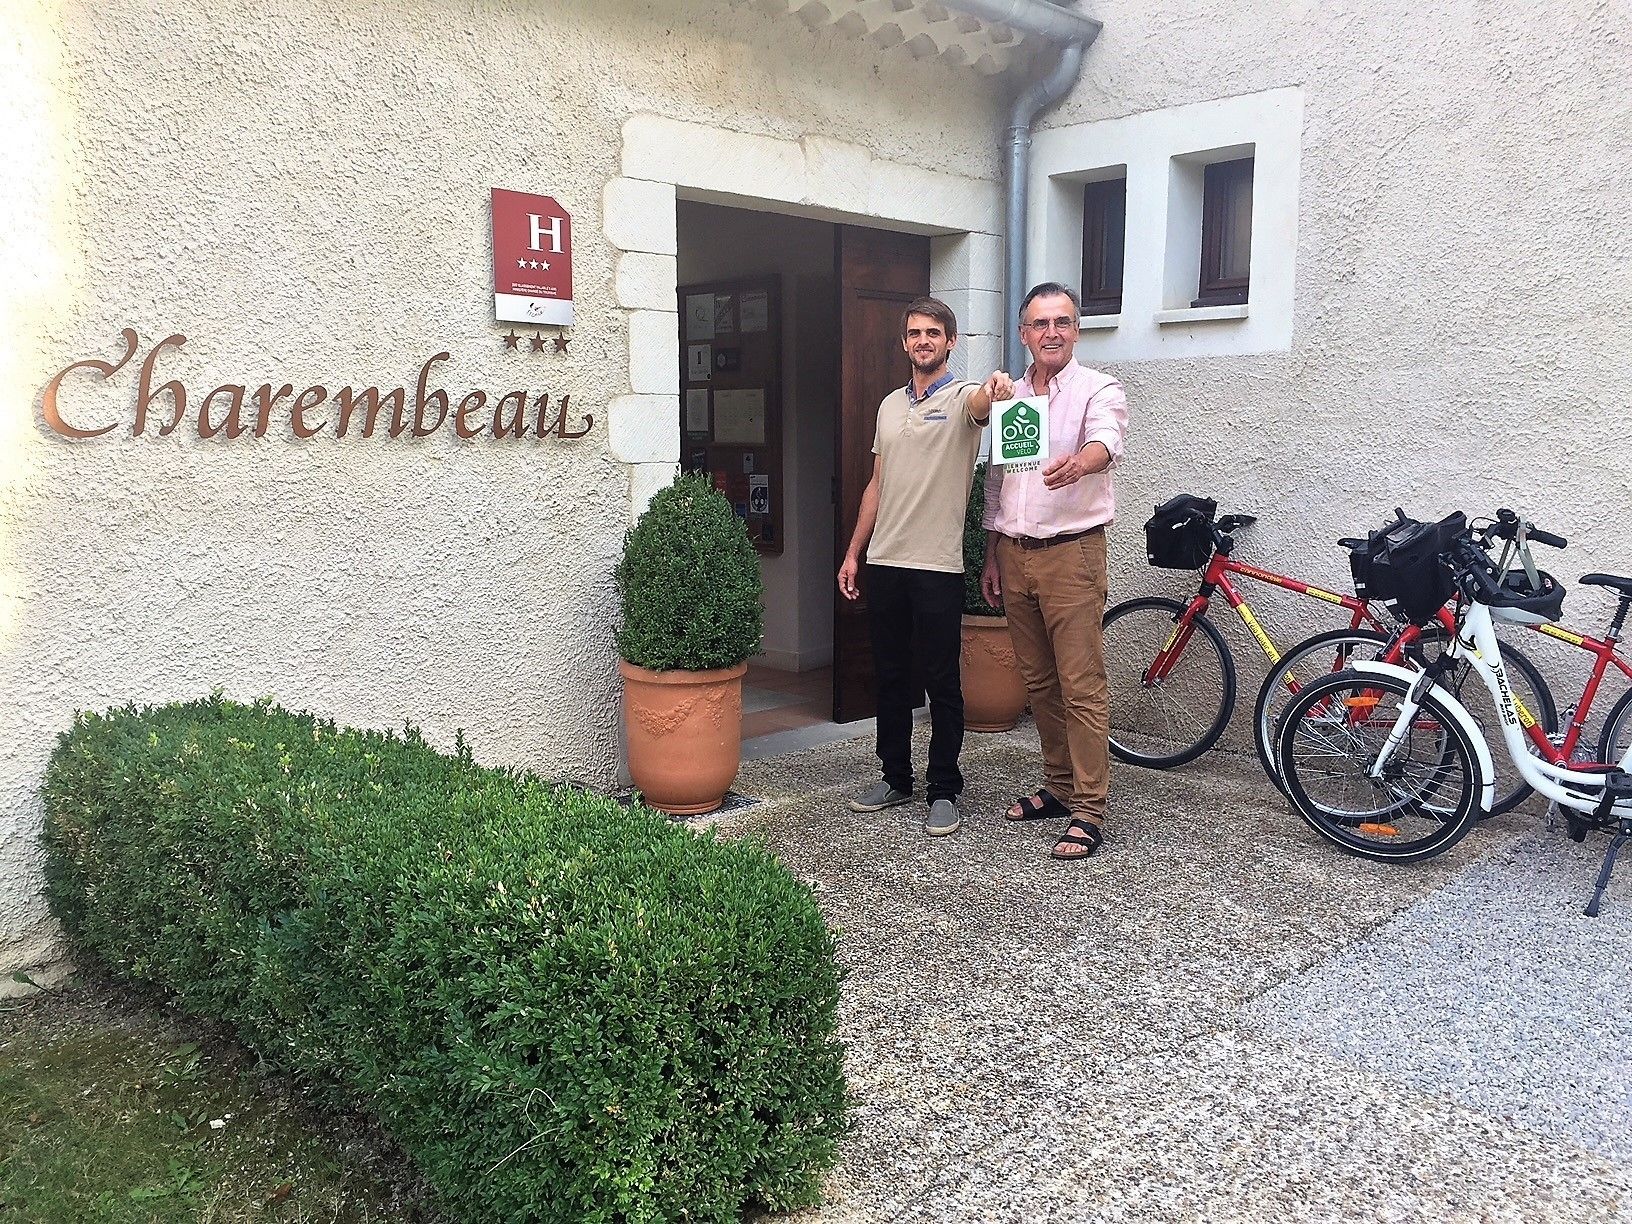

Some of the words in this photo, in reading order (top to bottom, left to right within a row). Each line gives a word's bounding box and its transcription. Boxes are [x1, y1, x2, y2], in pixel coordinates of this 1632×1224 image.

[525, 212, 565, 254] H
[42, 327, 594, 440] Charembeau
[1005, 441, 1034, 451] ACCUEIL
[1007, 466, 1038, 474] WELCOME
[1495, 667, 1517, 725] BACHELAS
